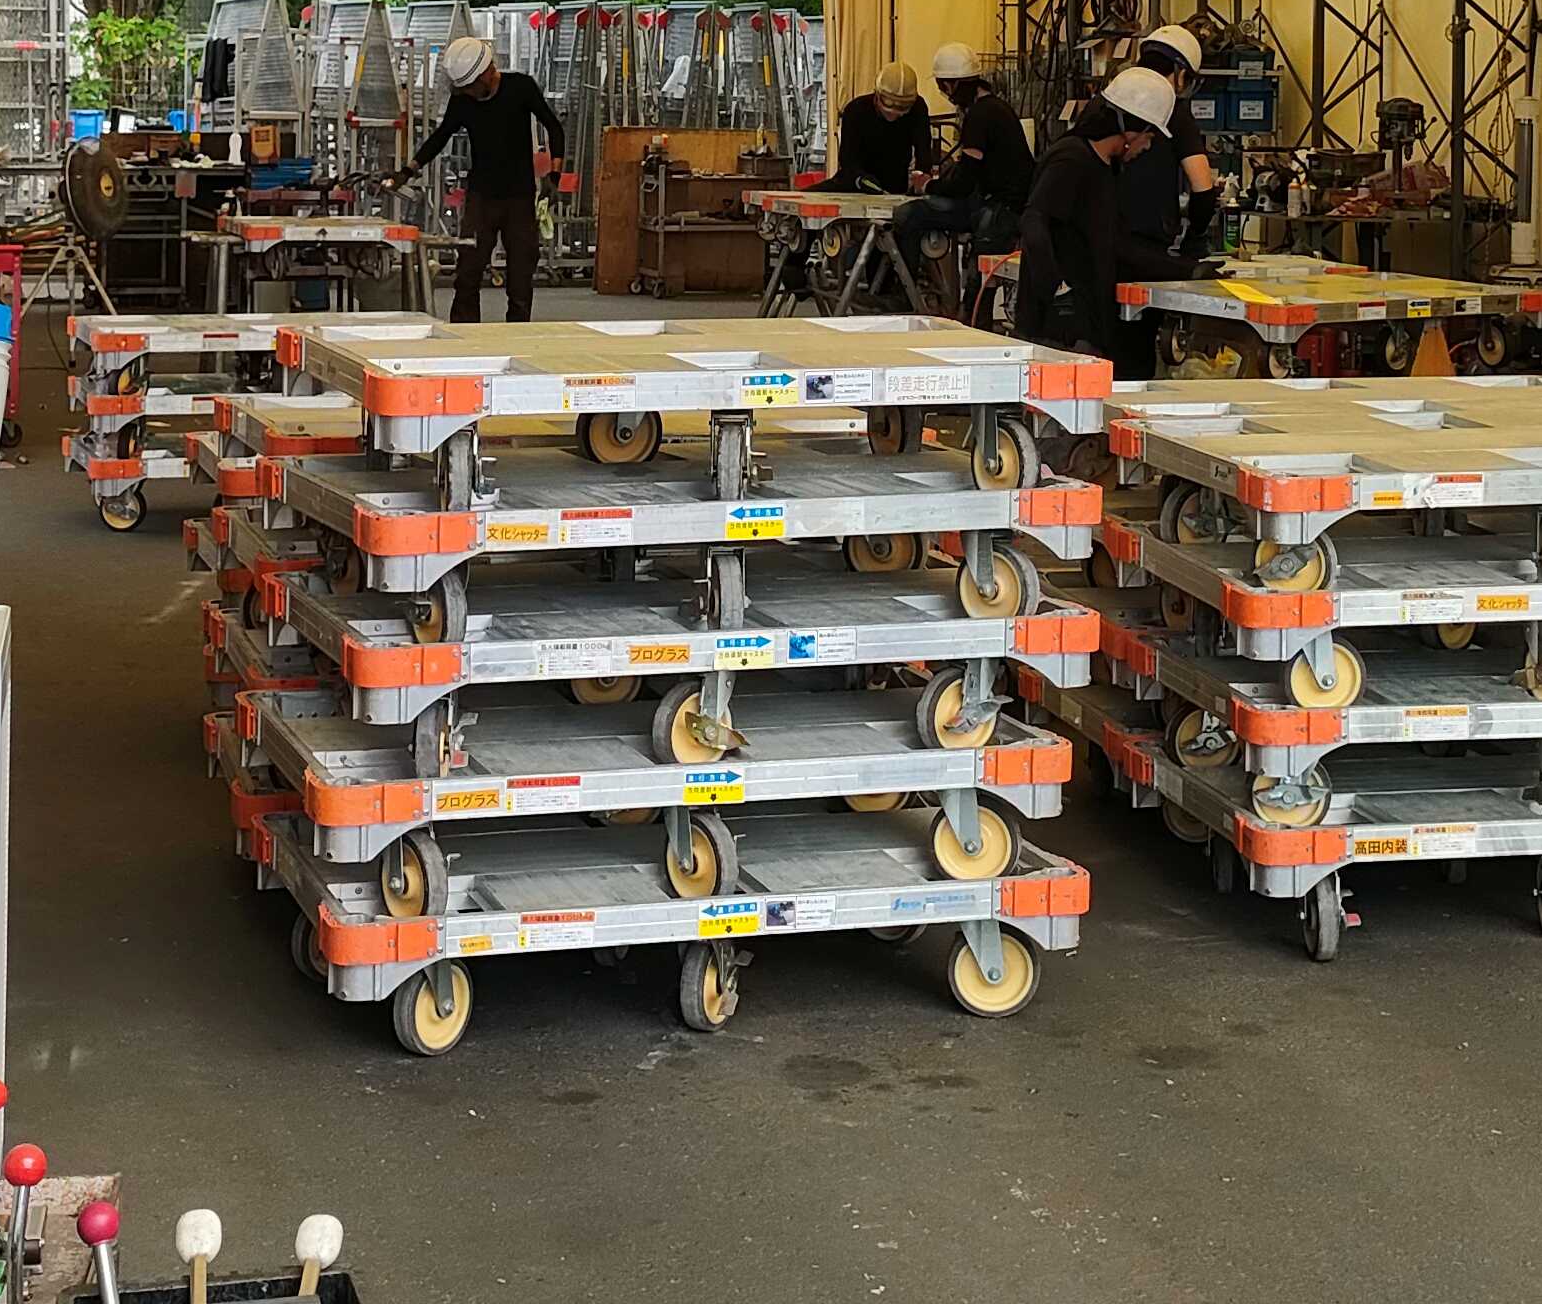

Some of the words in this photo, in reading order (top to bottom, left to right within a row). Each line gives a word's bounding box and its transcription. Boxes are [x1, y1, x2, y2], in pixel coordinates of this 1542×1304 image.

[487, 526, 547, 541] 文化シャッター
[1476, 598, 1528, 611] 文化シャッター
[631, 648, 689, 662] プログラス
[438, 792, 499, 811] プログラス
